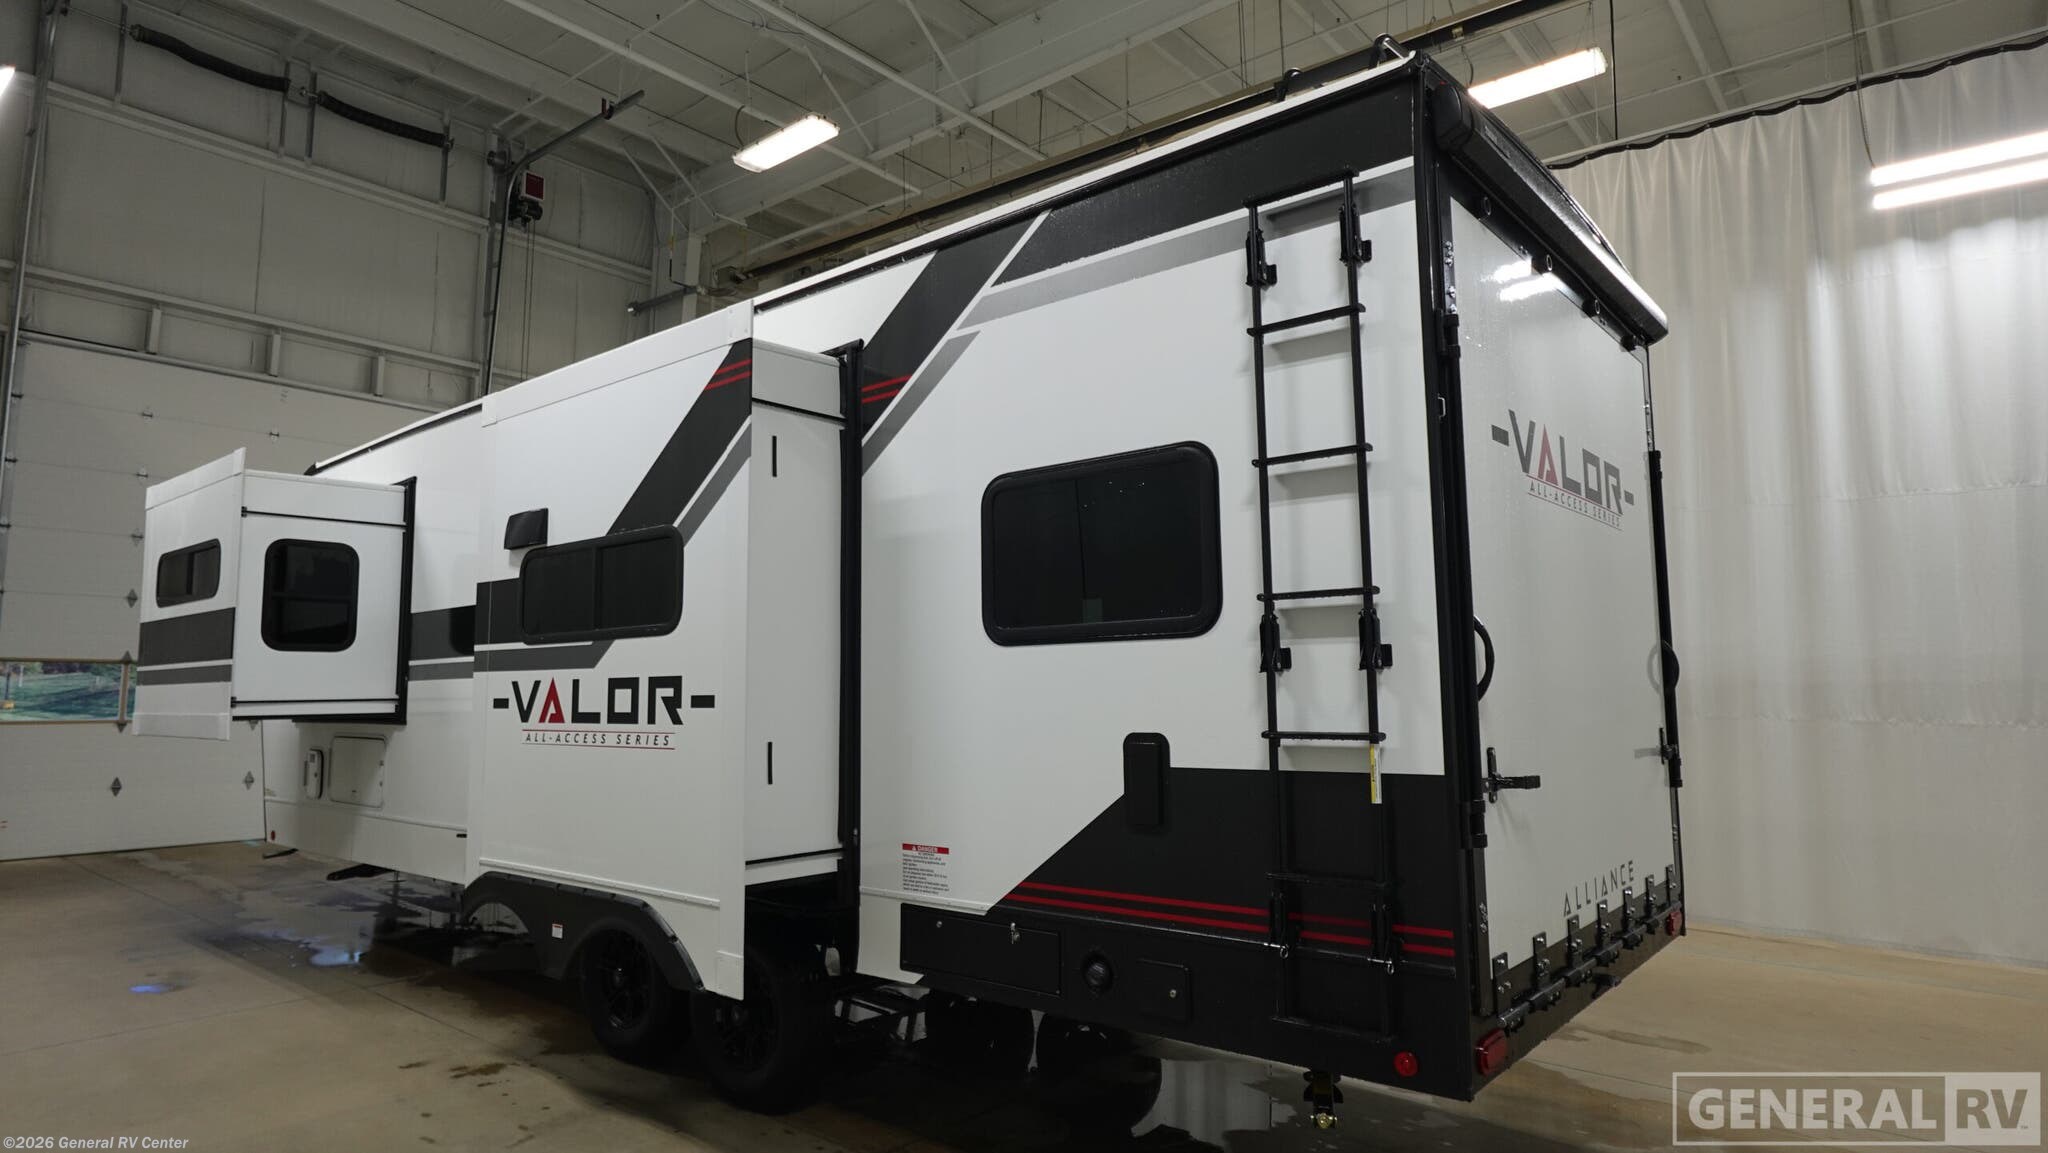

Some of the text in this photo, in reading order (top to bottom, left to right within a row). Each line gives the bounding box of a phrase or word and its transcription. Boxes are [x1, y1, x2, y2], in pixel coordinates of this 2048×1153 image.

[1529, 480, 1620, 528] ALL-ACCESS SERIES
[525, 733, 670, 747] ALL-ACCESS SERIES
[1563, 860, 1634, 917] ALLIANCE
